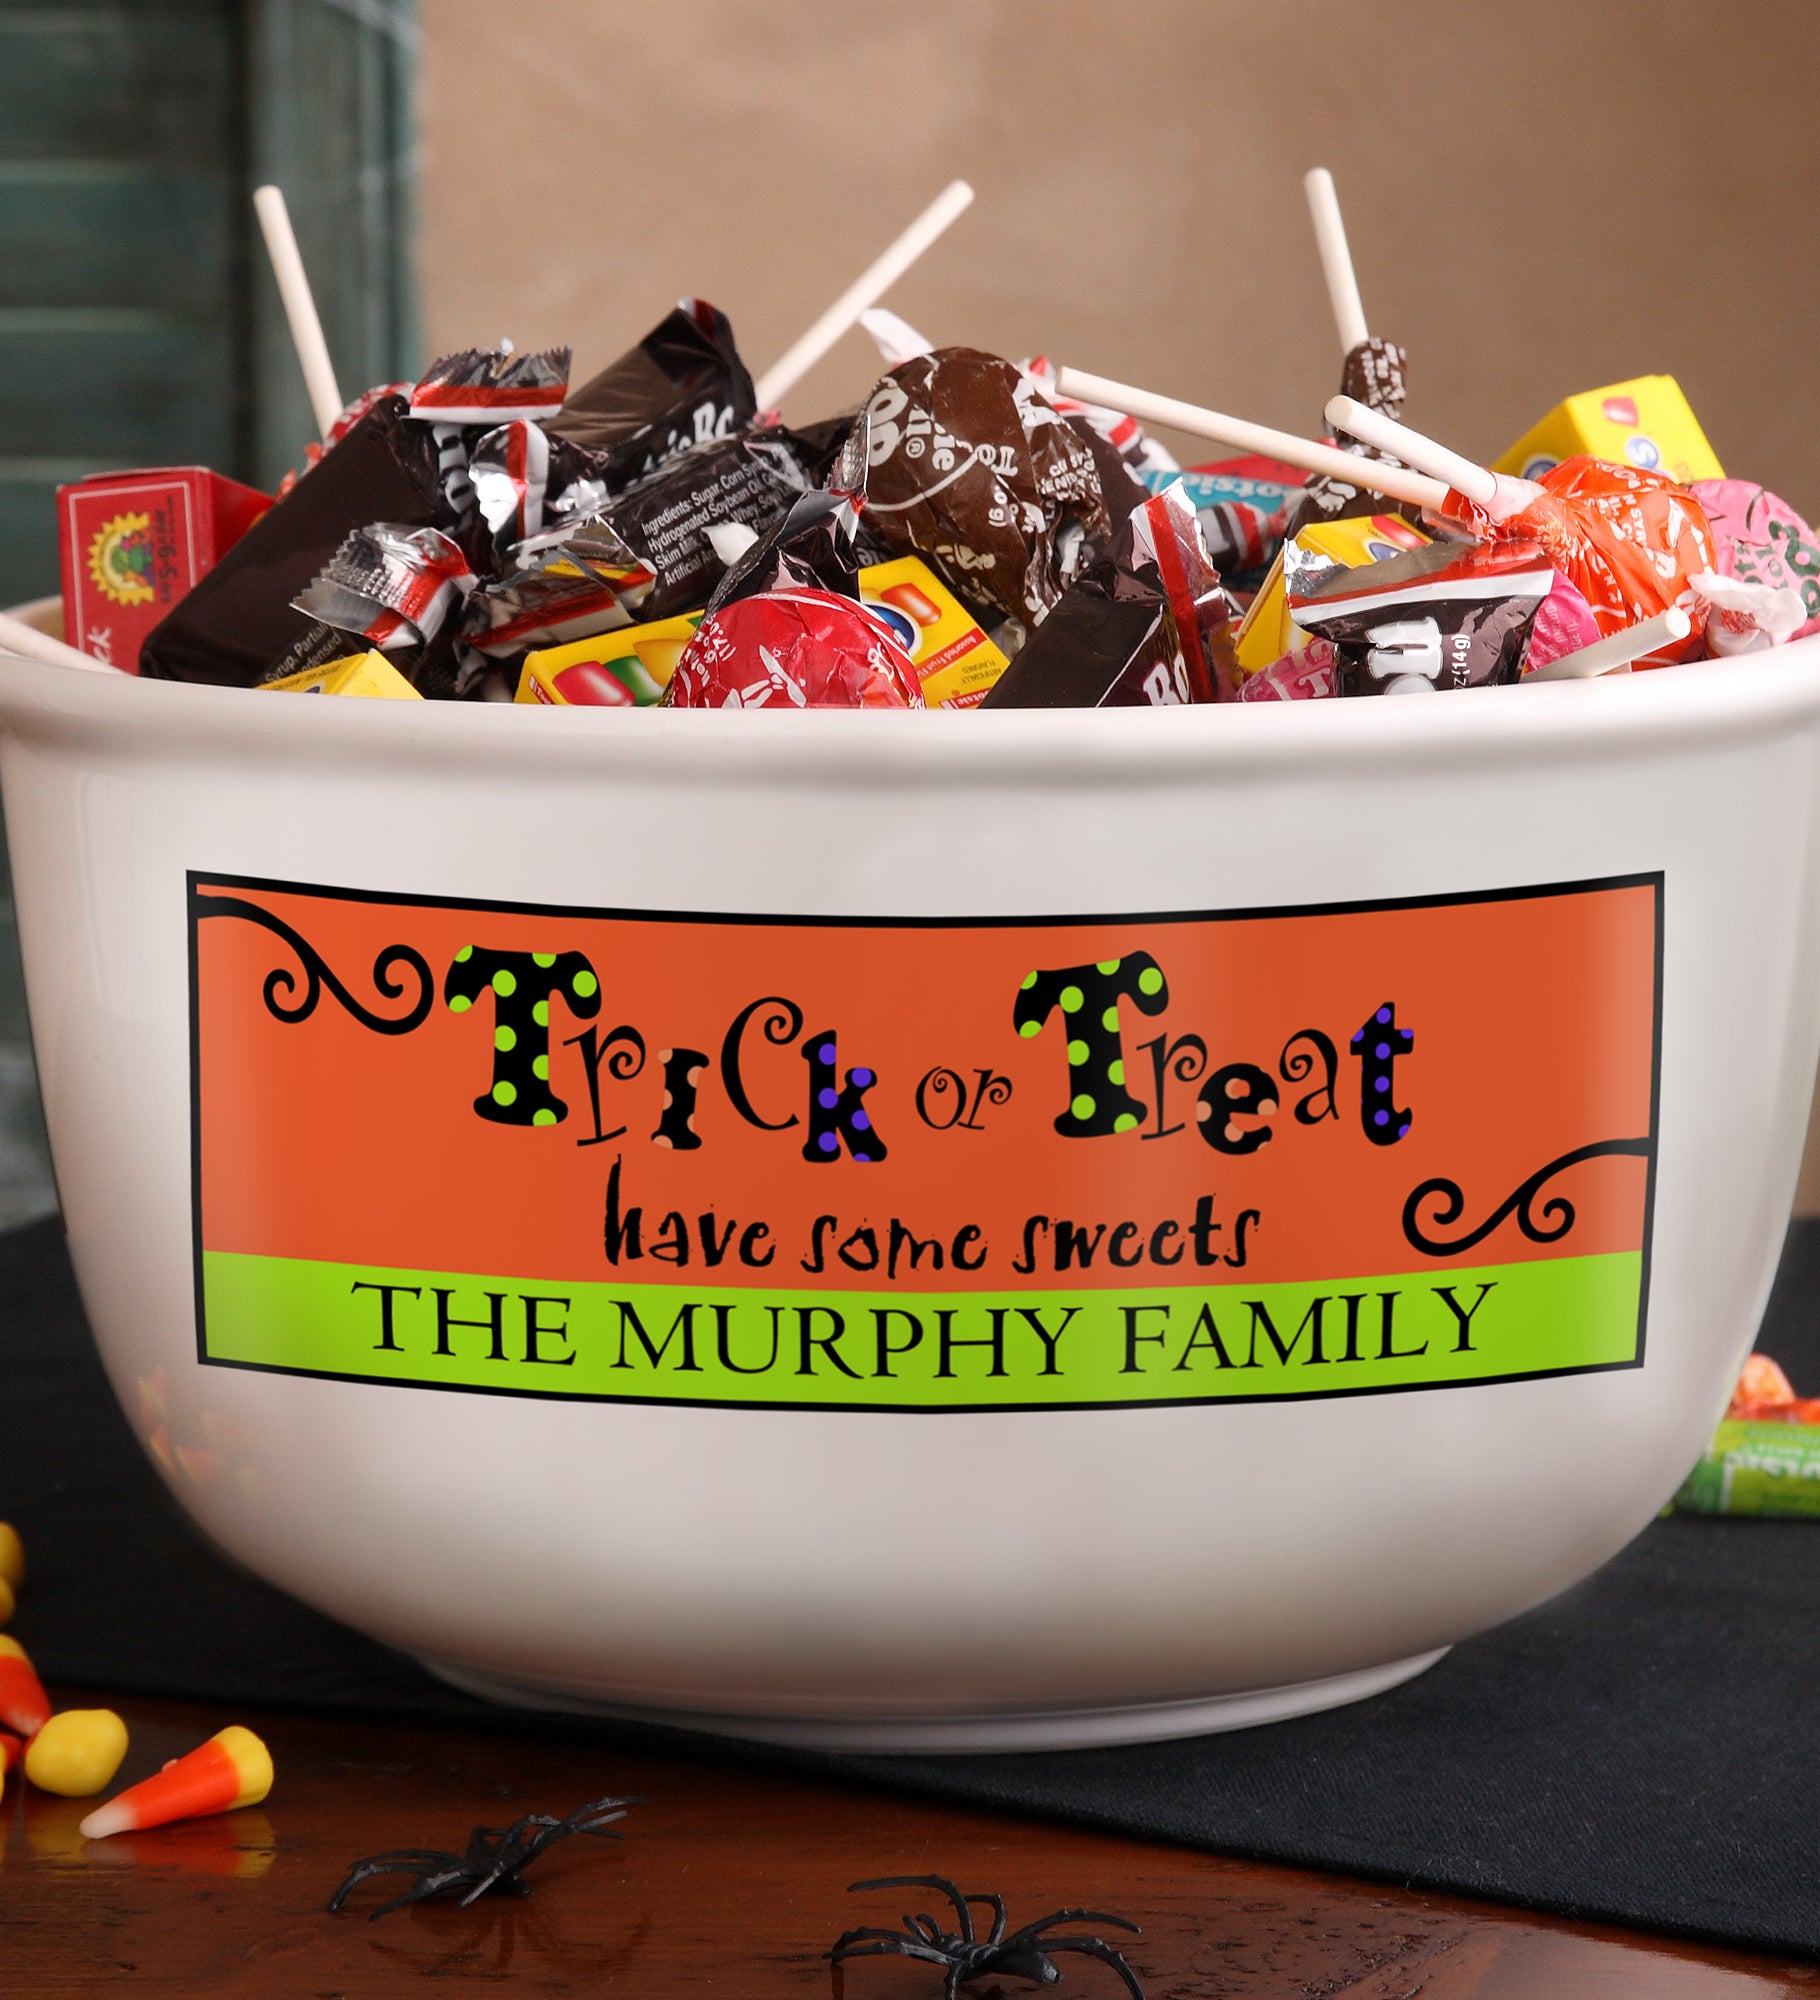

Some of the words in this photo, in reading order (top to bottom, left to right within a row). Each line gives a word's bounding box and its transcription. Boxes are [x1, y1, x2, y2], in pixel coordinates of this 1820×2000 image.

[641, 499, 693, 537] Ingredients:
[720, 470, 745, 490] Corn
[647, 511, 710, 553] Hydrogenated
[708, 490, 750, 518] Soybean
[655, 545, 682, 570] Skim
[664, 557, 701, 587] Artificial
[444, 944, 887, 1163] Trick
[915, 1066, 1013, 1131] or
[1013, 950, 1415, 1156] Treat
[604, 1153, 777, 1267] have
[800, 1213, 988, 1280] some
[1012, 1192, 1262, 1276] sweets
[351, 1281, 578, 1367] THE
[608, 1300, 1084, 1380] MURPHY
[1117, 1282, 1499, 1375] FAMILY
